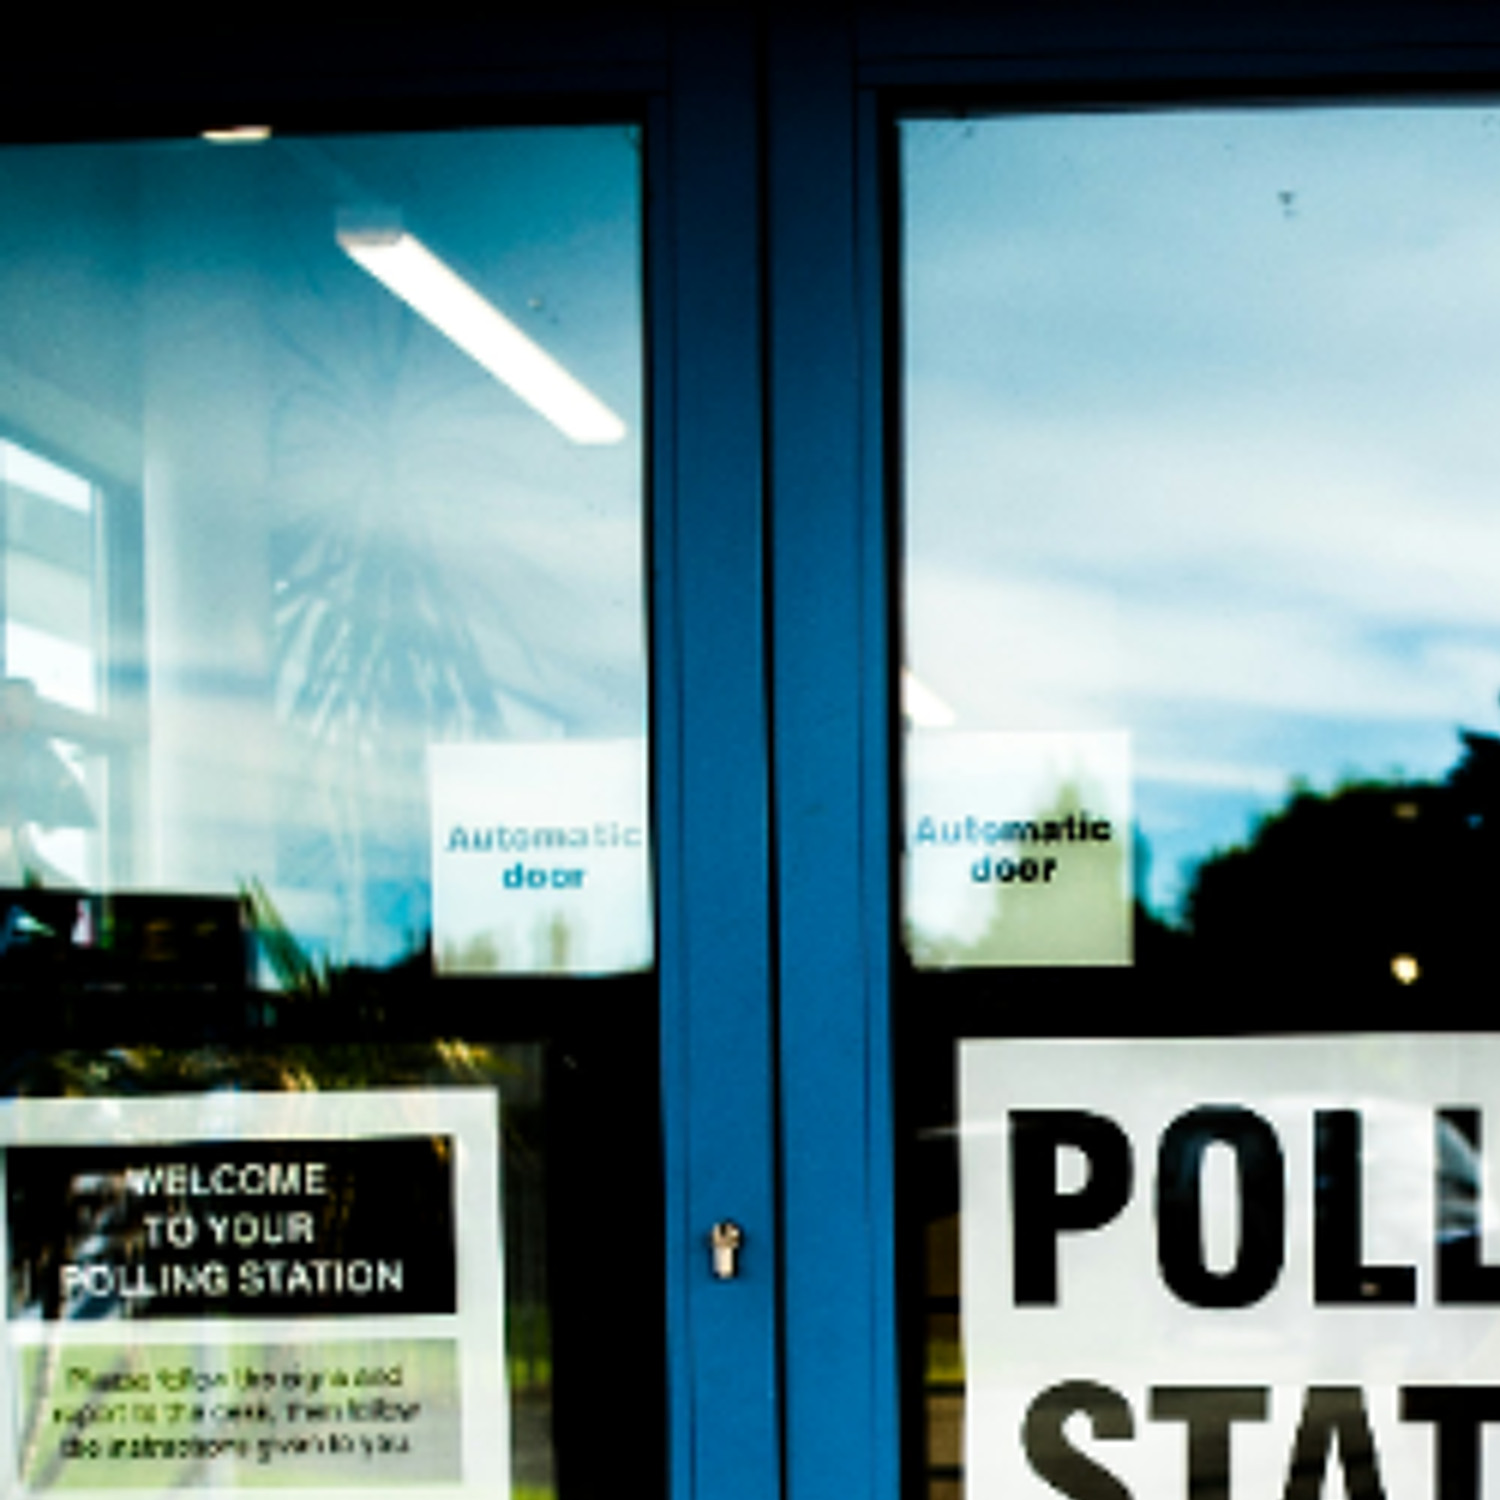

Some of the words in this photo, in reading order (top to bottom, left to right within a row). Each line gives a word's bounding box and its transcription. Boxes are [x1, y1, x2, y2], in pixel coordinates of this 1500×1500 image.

[446, 823, 642, 852] Automatic
[916, 813, 1112, 843] Automatic
[502, 863, 586, 889] door
[971, 855, 1056, 884] door
[125, 1162, 329, 1197] WELCOME
[143, 1214, 195, 1248] TO
[208, 1212, 315, 1246] YOUR
[60, 1262, 229, 1297] POLLING
[238, 1260, 403, 1294] STATION
